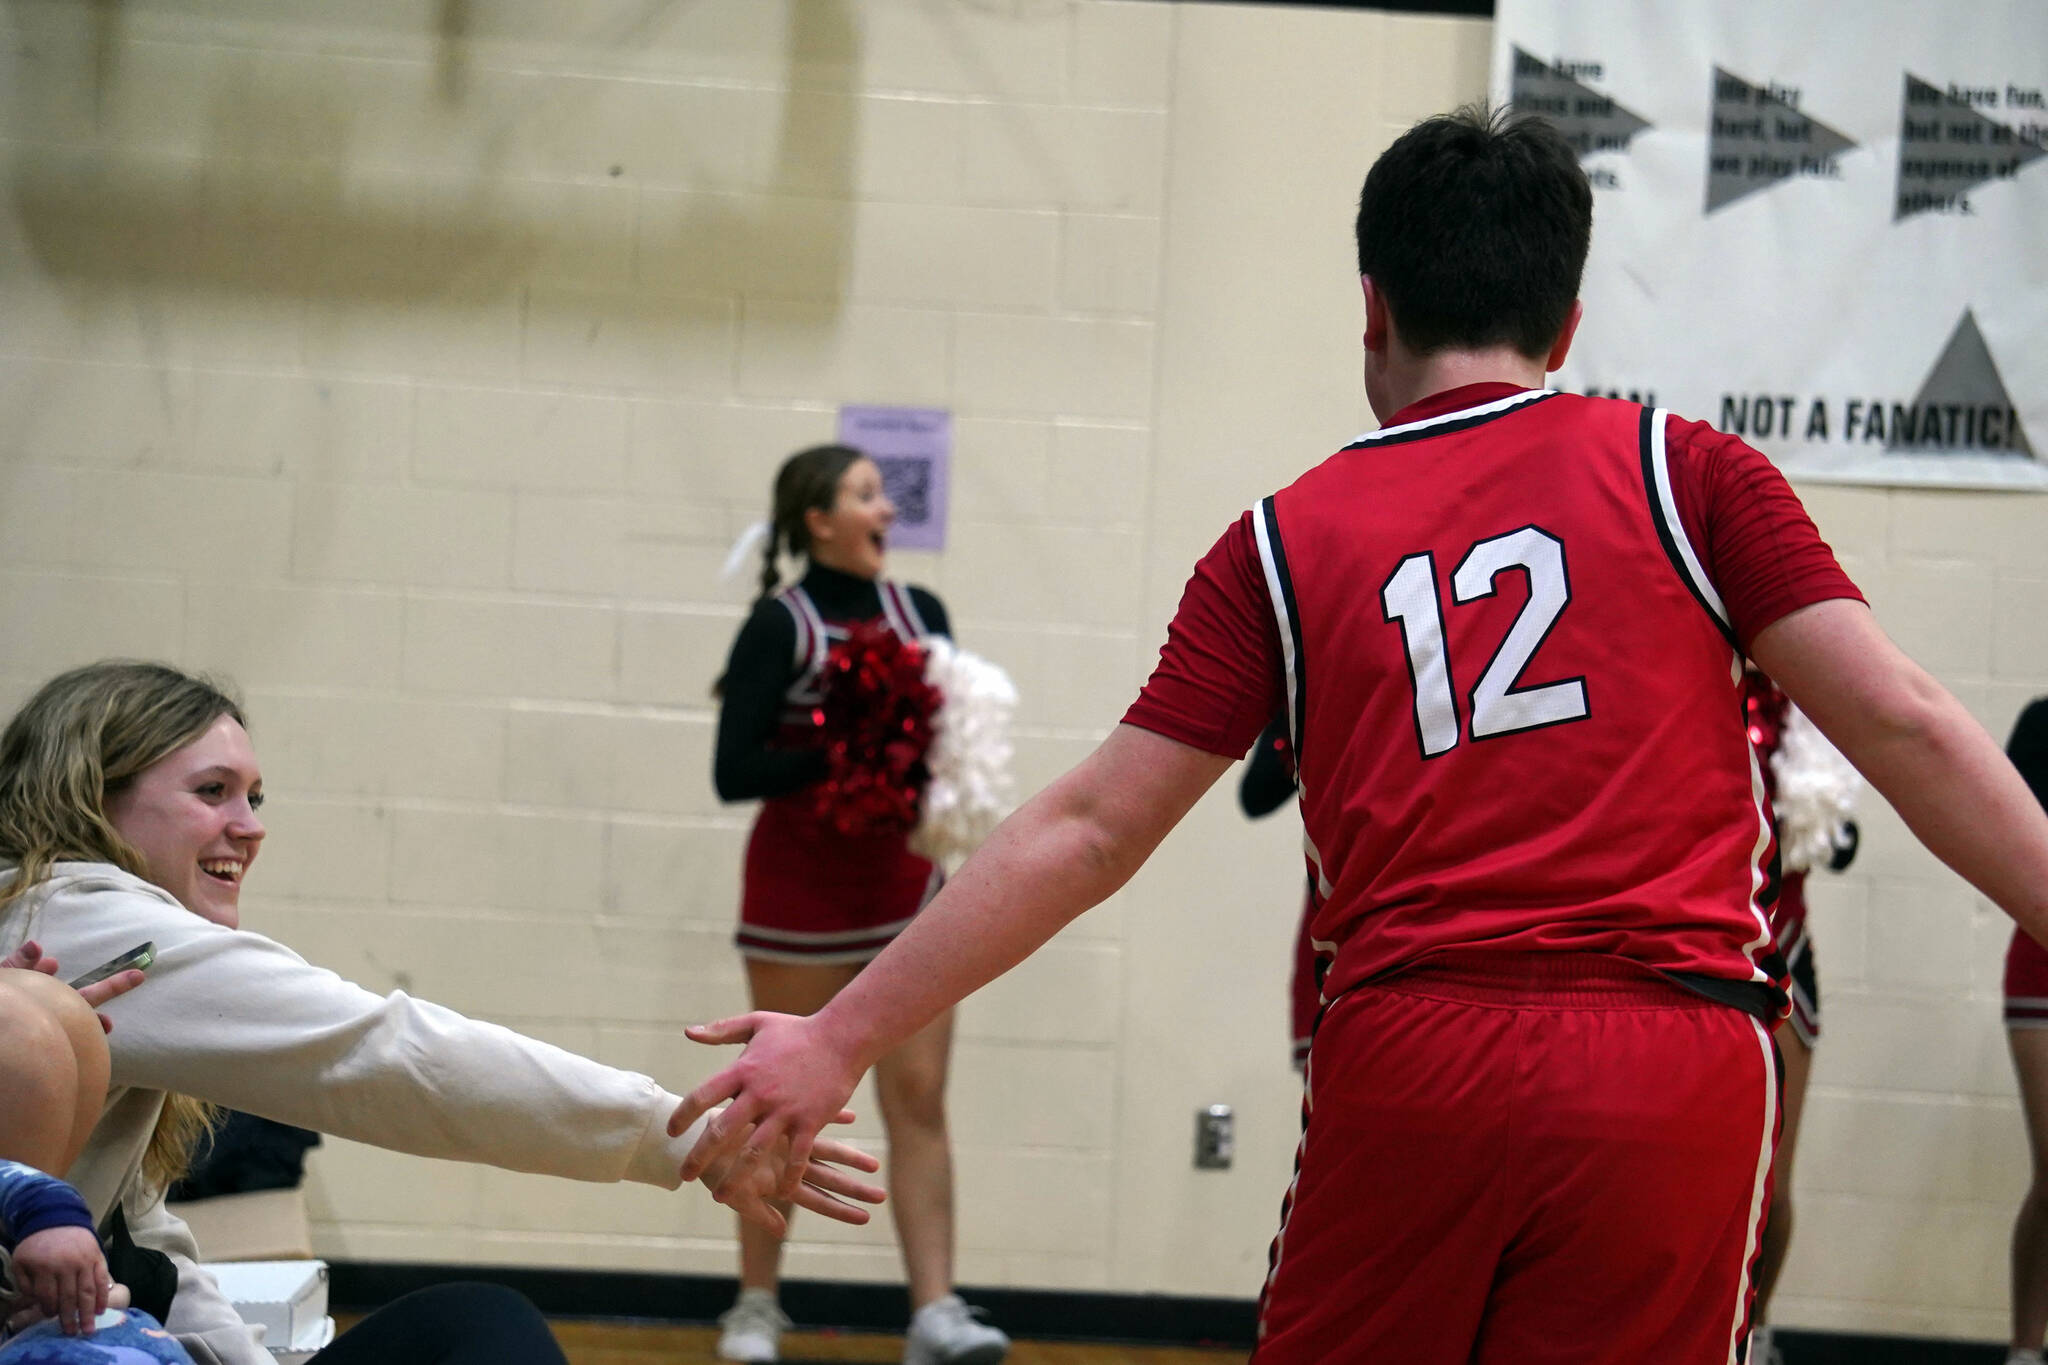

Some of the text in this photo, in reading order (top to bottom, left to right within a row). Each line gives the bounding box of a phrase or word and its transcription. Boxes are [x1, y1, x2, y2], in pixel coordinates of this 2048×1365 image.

[1756, 80, 1801, 110] play
[1948, 79, 1997, 108] have
[1775, 116, 1811, 142] but
[1902, 117, 1940, 143] but
[1948, 121, 1982, 144] not
[1720, 394, 2020, 450] NOT A FANATIC!
[1379, 523, 1592, 761] 12
